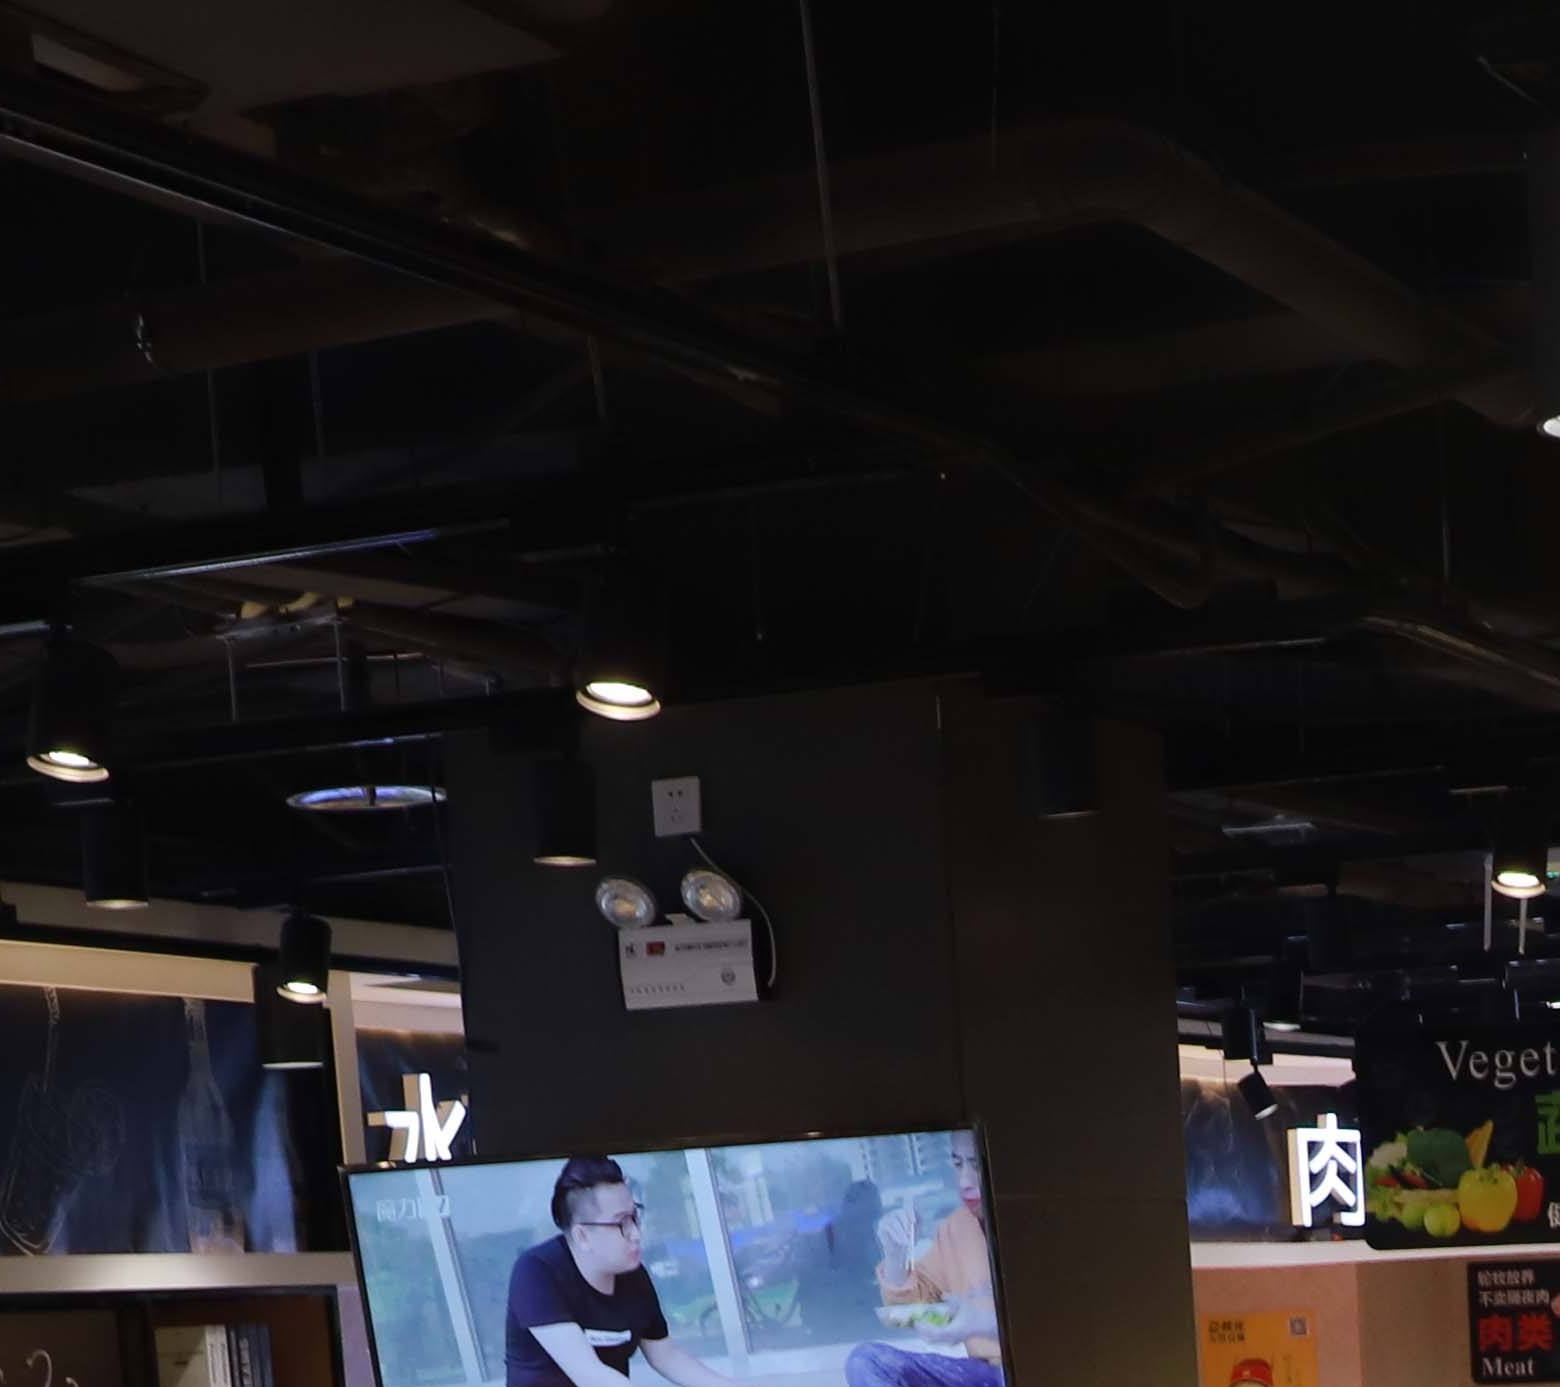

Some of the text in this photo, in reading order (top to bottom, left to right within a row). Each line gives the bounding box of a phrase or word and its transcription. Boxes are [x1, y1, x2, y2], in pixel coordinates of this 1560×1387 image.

[1297, 1113, 1366, 1228] 肉
[1479, 1313, 1553, 1352] 肉类
[1482, 1356, 1536, 1378] Meat
